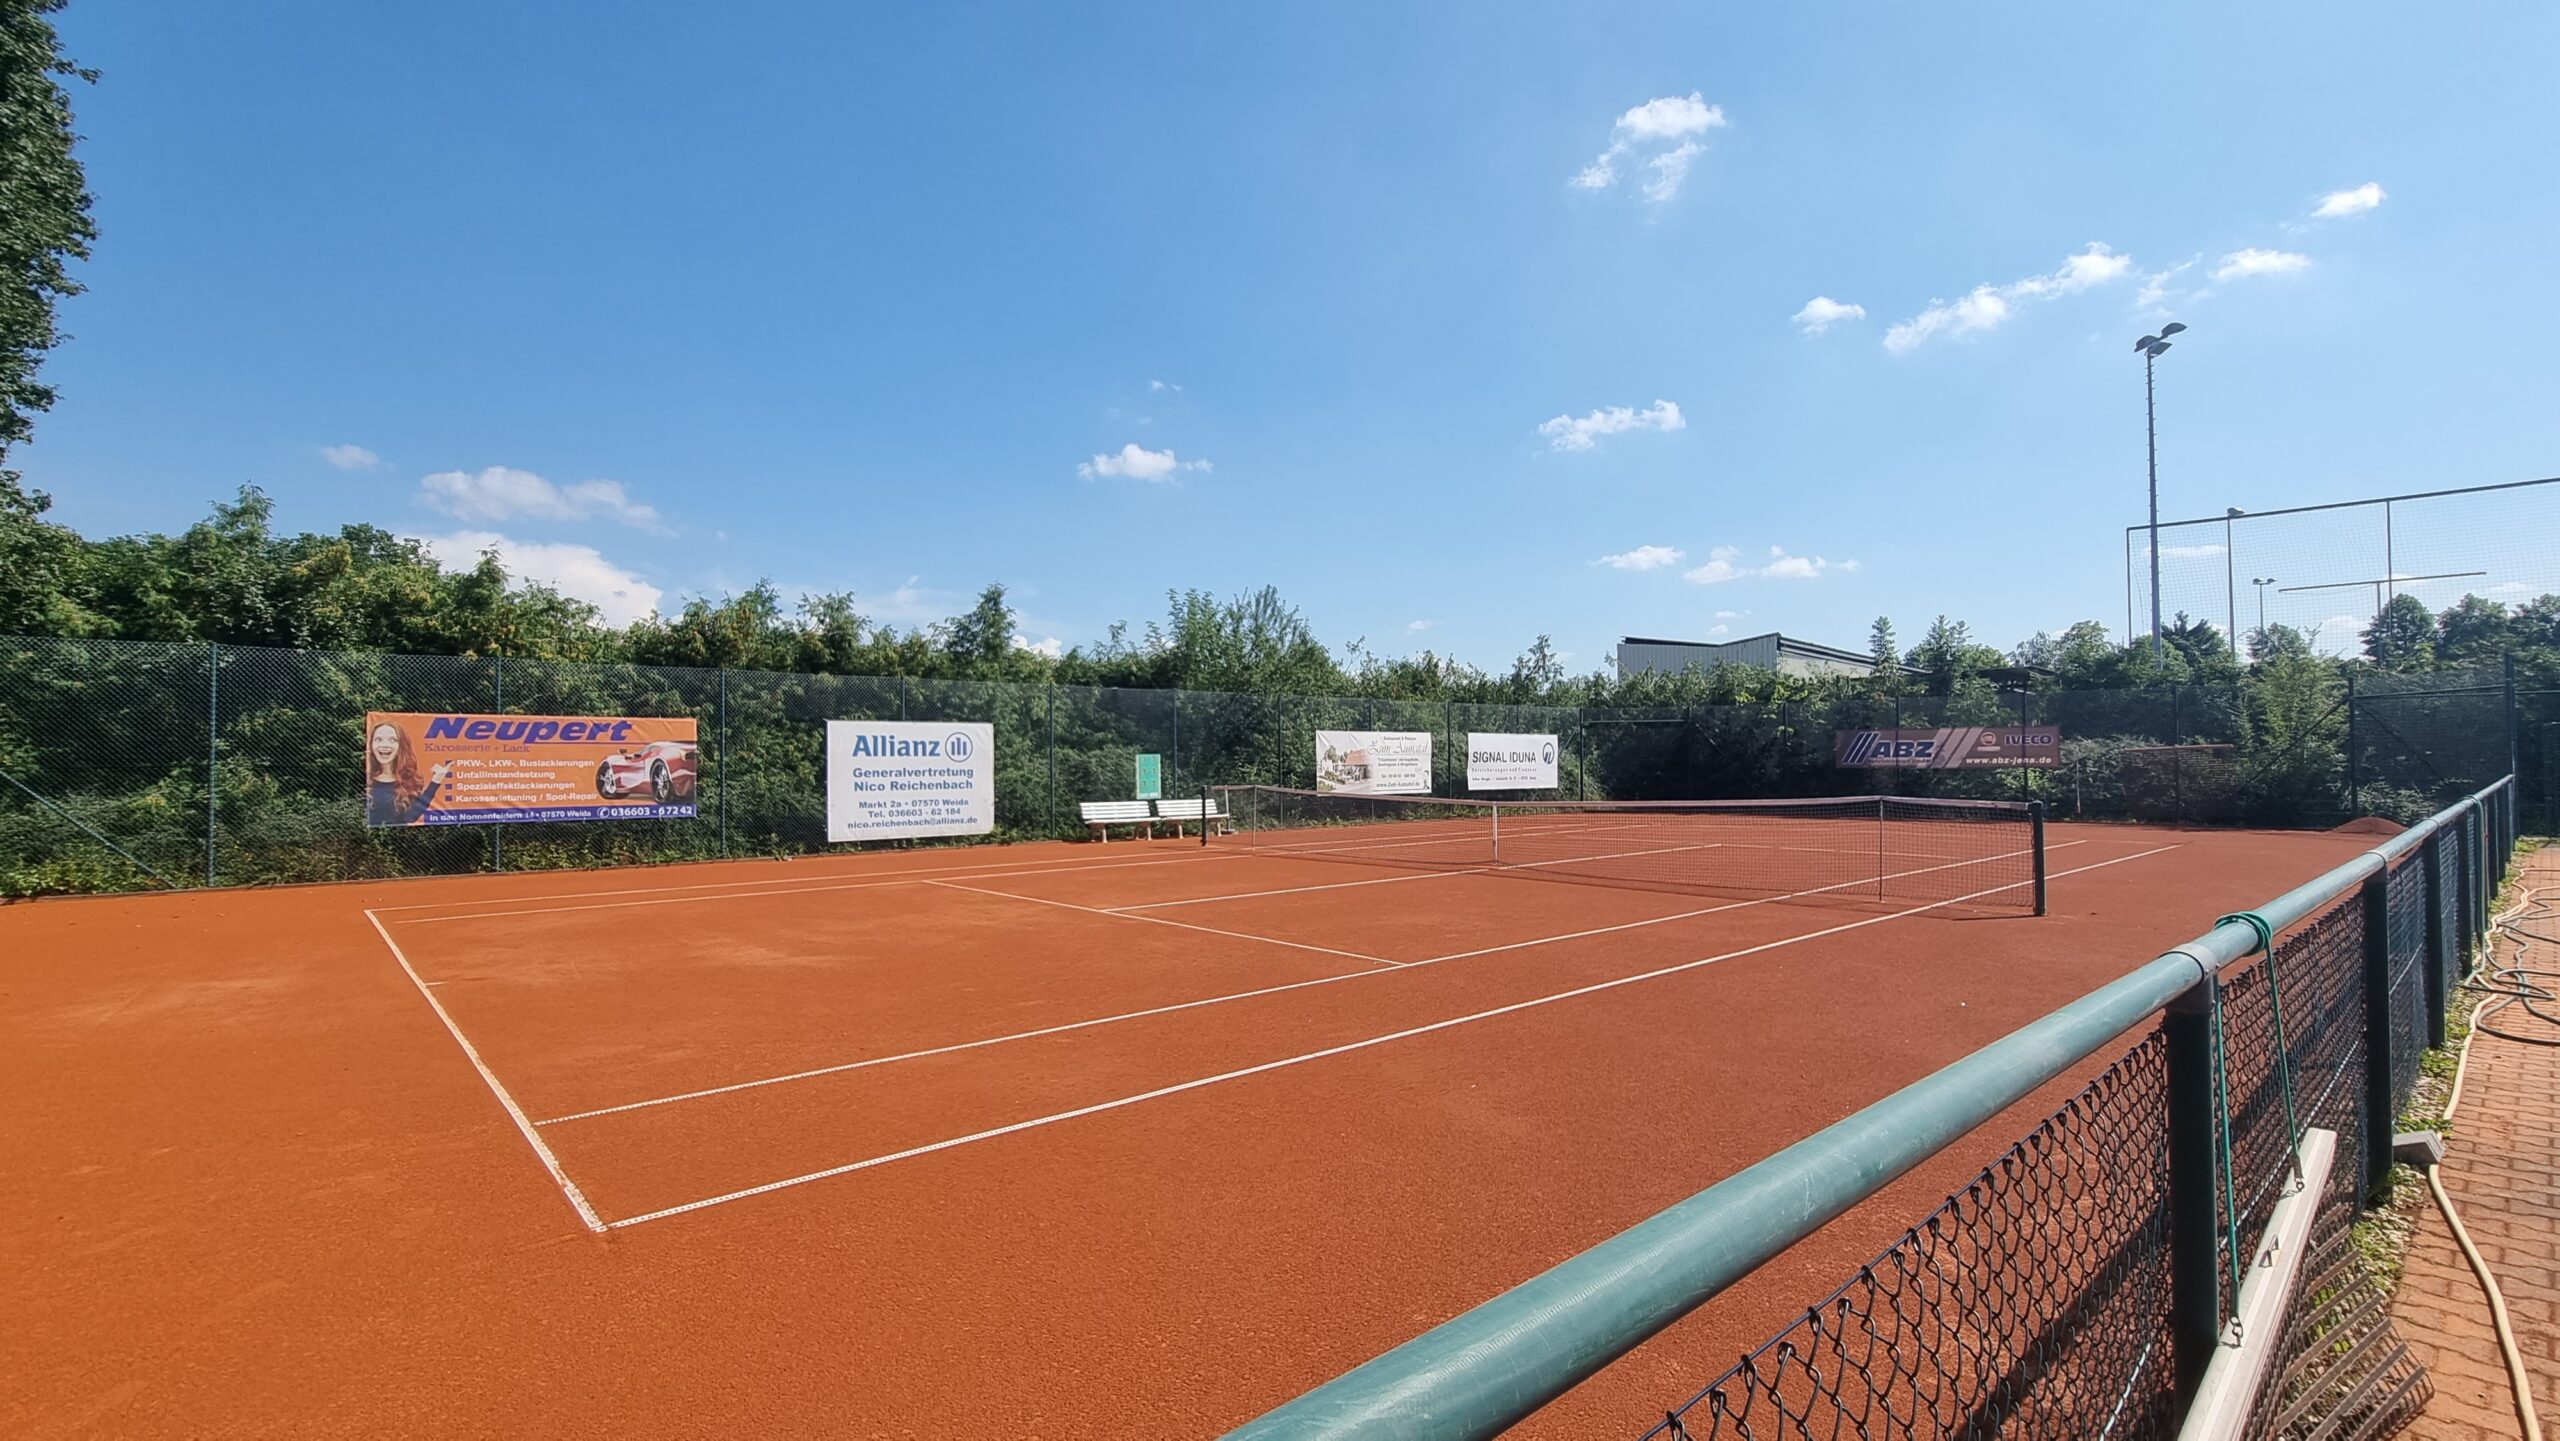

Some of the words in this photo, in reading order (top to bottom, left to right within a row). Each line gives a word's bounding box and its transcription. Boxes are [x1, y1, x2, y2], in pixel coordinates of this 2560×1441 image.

[424, 717, 632, 744] Neupert
[852, 734, 941, 757] Allianz
[2004, 734, 2053, 746] IVECO
[424, 743, 491, 753] Karosserie
[502, 744, 530, 753] Lack
[1870, 741, 1935, 758] ABZ
[1472, 751, 1508, 763] SIGNAL
[1509, 751, 1537, 763] IDUNA
[1965, 756, 2053, 766] www.abz-jena.de
[457, 759, 487, 768] PKW-,
[489, 759, 518, 768] LKW-,
[520, 759, 594, 768] Buslackierungen
[457, 771, 555, 780] Unfallinstandsetzung
[852, 767, 974, 779] Generalvertretung
[457, 782, 576, 791] Spezialeffektlackierungen
[854, 781, 886, 792] Nico
[890, 779, 974, 791] Reichenbach
[456, 794, 537, 803] Karosserietuning
[859, 801, 888, 810] Markt
[890, 800, 902, 808] 2a
[911, 799, 940, 808] 07570
[942, 798, 969, 806] Weida
[567, 809, 592, 818] Weida
[610, 806, 650, 817] 036603
[868, 810, 886, 818] Tel.
[888, 809, 923, 818] 036603
[847, 816, 978, 829] nico.reichenbach@allianz.de
